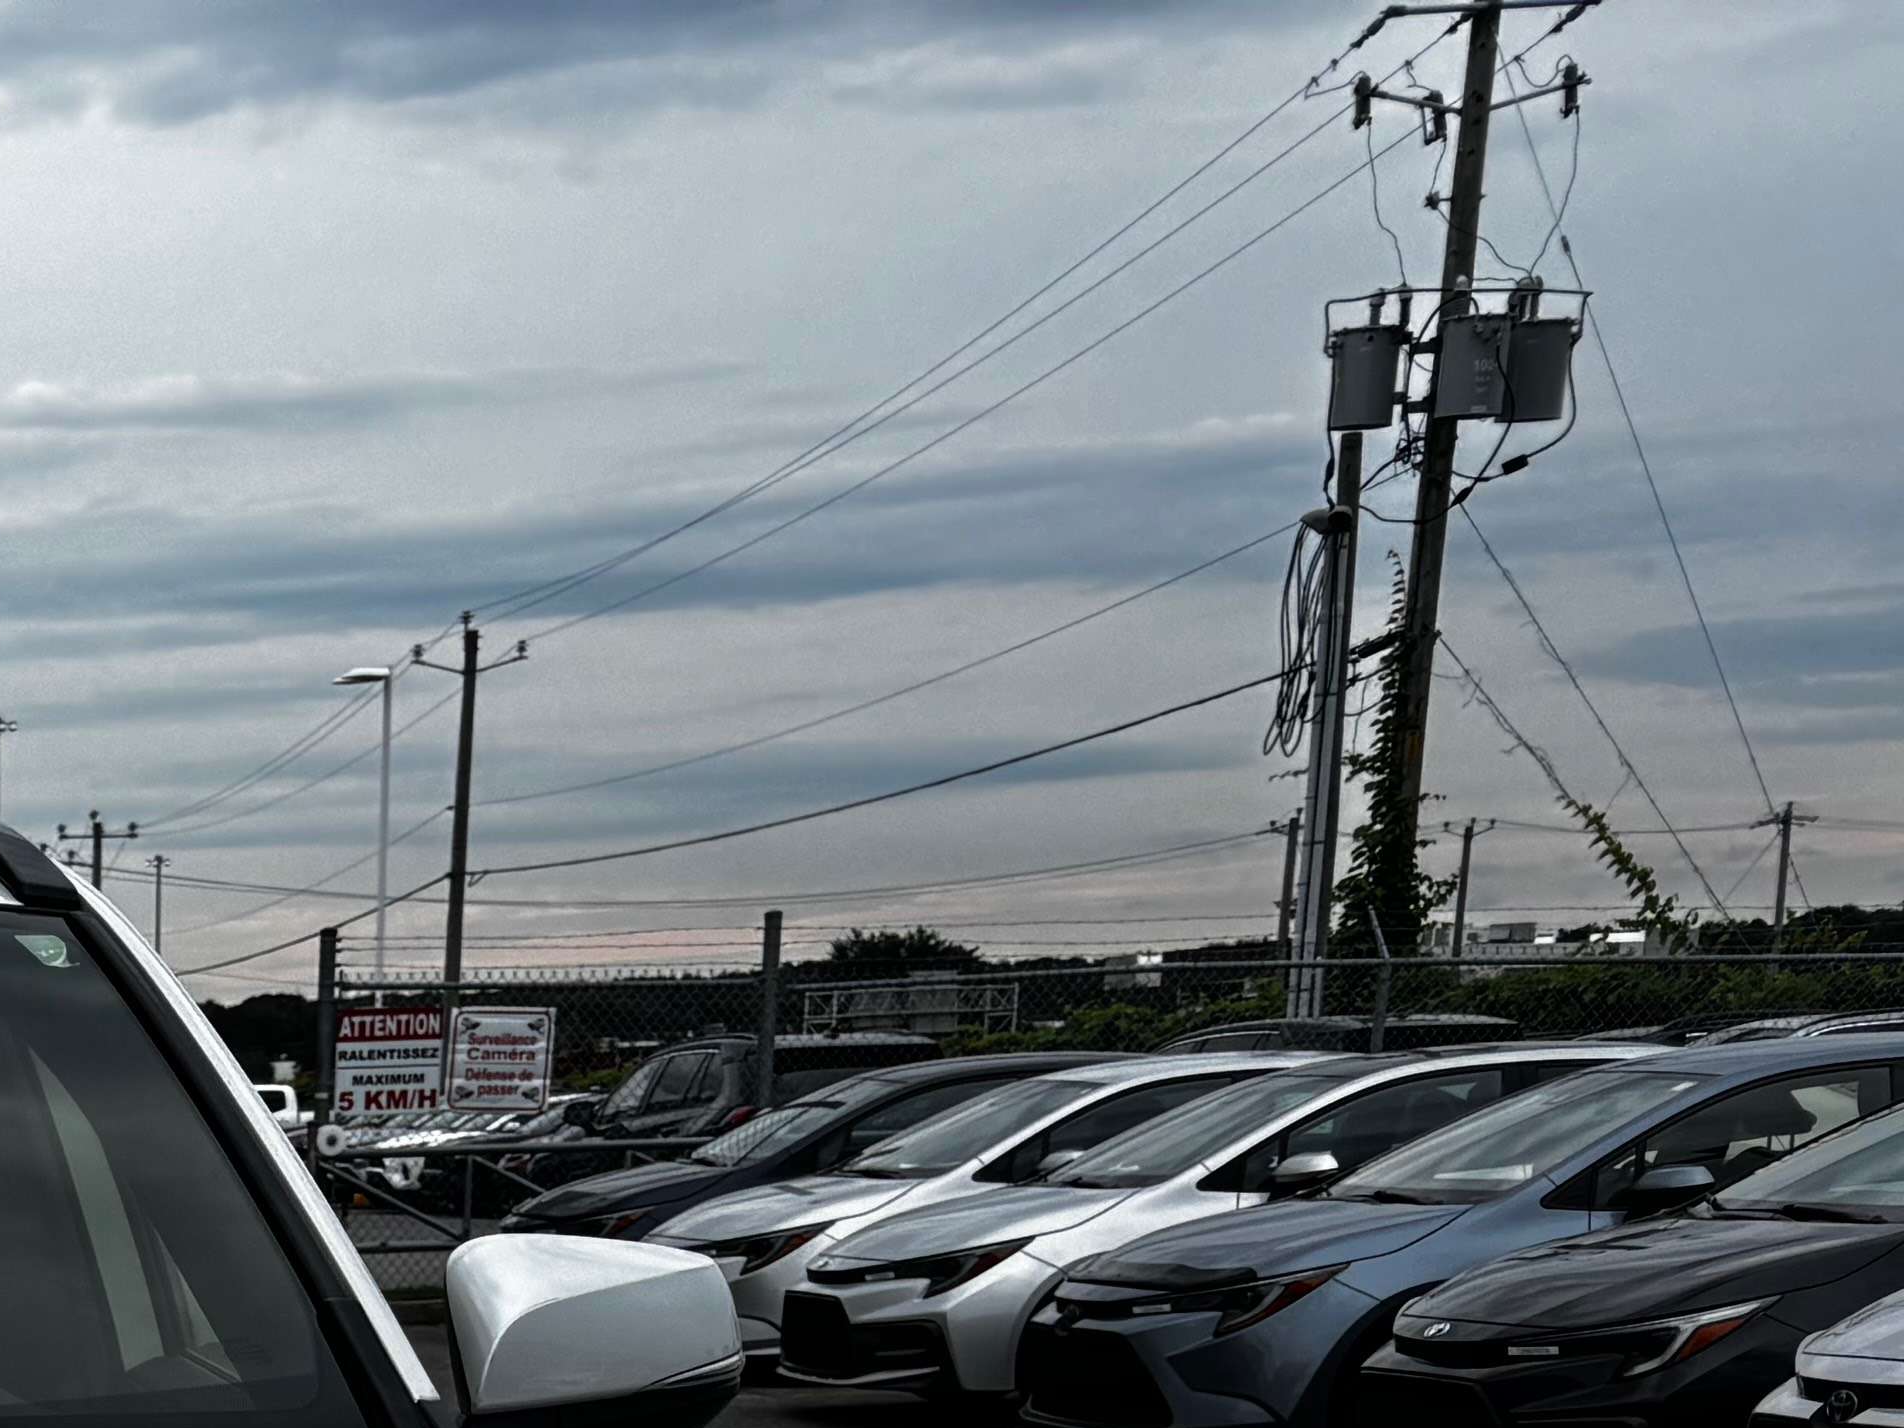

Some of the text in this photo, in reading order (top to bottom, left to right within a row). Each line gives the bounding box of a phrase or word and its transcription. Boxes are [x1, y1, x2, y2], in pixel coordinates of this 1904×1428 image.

[339, 1013, 440, 1037] ATTENTION
[467, 1032, 538, 1045] Surveillance
[338, 1047, 439, 1061] RALENTISSEZ
[467, 1047, 536, 1060] Caméra
[352, 1073, 425, 1086] MAXIMUM
[465, 1067, 535, 1081] Défense de
[477, 1085, 520, 1097] passer
[339, 1088, 437, 1112] 5 KM/H
